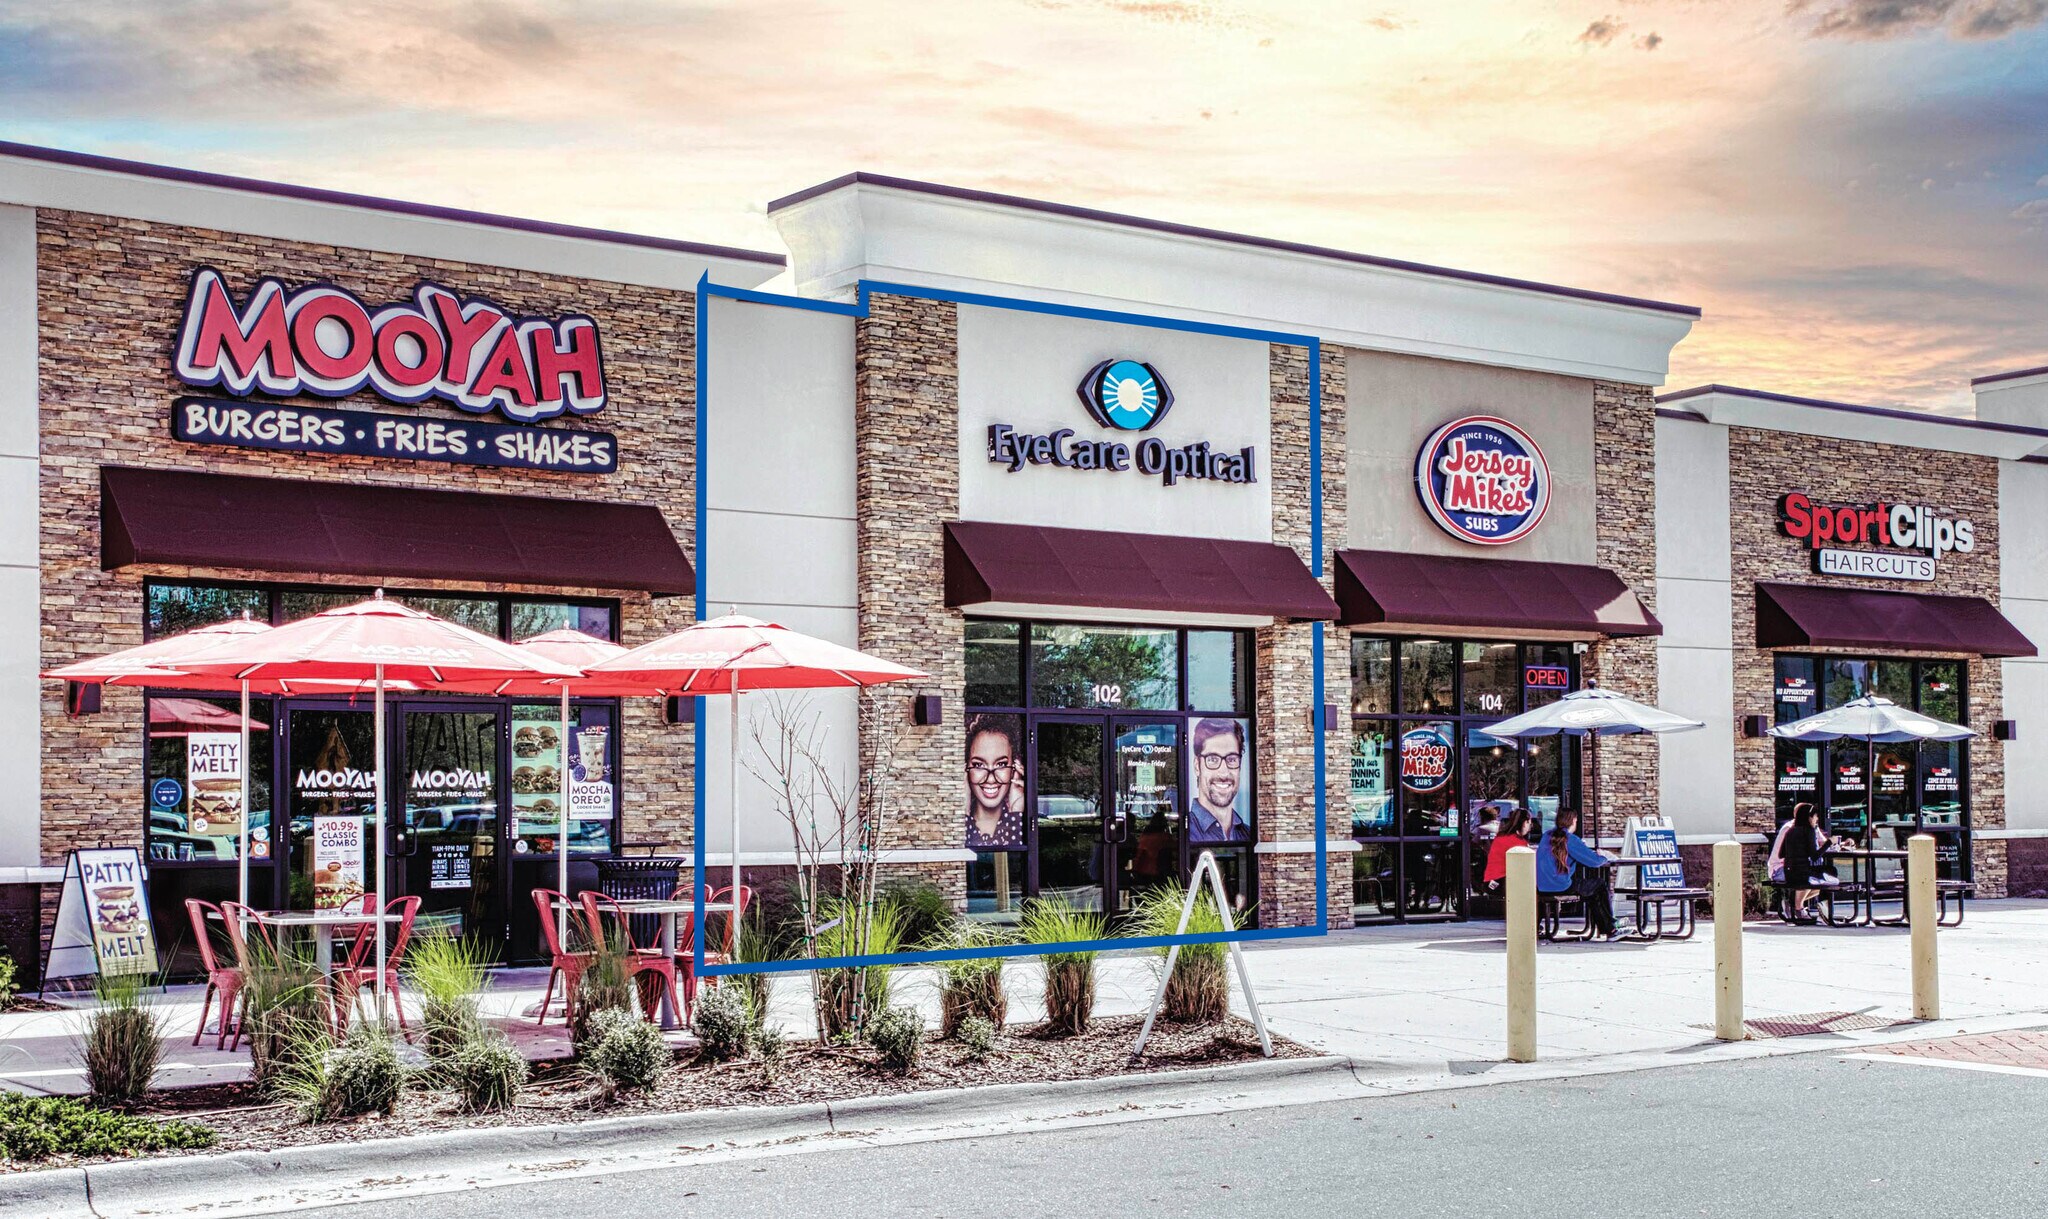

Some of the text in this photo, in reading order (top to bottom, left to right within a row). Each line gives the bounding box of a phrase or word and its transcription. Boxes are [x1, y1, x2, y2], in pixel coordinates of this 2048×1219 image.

[188, 275, 605, 408] MOOYAH
[186, 404, 612, 466] BURGERS FRIES SHAKES
[1461, 432, 1503, 445] SINCE 1956
[987, 424, 1258, 487] EyeCare Optical
[1445, 440, 1532, 488] Jersey
[1450, 474, 1531, 512] Mike's
[1465, 517, 1499, 531] SUBS
[1824, 553, 1932, 577] HAIRCUTS
[1526, 669, 1567, 685] OPEN
[1092, 684, 1121, 703] 102
[1479, 694, 1503, 710] 104
[191, 743, 238, 757] PATTY
[1121, 745, 1172, 753] EyeCare Optical
[1402, 740, 1447, 762] Jersey
[191, 758, 238, 773] MELT
[1127, 760, 1146, 768] Monday
[1151, 760, 1166, 768] Friday
[1351, 758, 1365, 768] OIN
[1403, 757, 1446, 777] Mike's
[296, 767, 377, 789] MOOYAH
[412, 767, 491, 789] MOOYAH
[1349, 768, 1381, 778] INNING
[571, 785, 611, 795] MOCHA
[1351, 779, 1375, 789] TEAM!
[571, 795, 602, 805] OREO
[321, 821, 354, 832] $10.99
[321, 831, 358, 840] CLASSIC
[321, 838, 358, 847] COMBO
[456, 844, 469, 852] DAILY
[1639, 840, 1676, 855] WINNING
[1642, 854, 1680, 875] TEAM
[83, 862, 134, 883] PATTY
[101, 935, 145, 959] MELT
